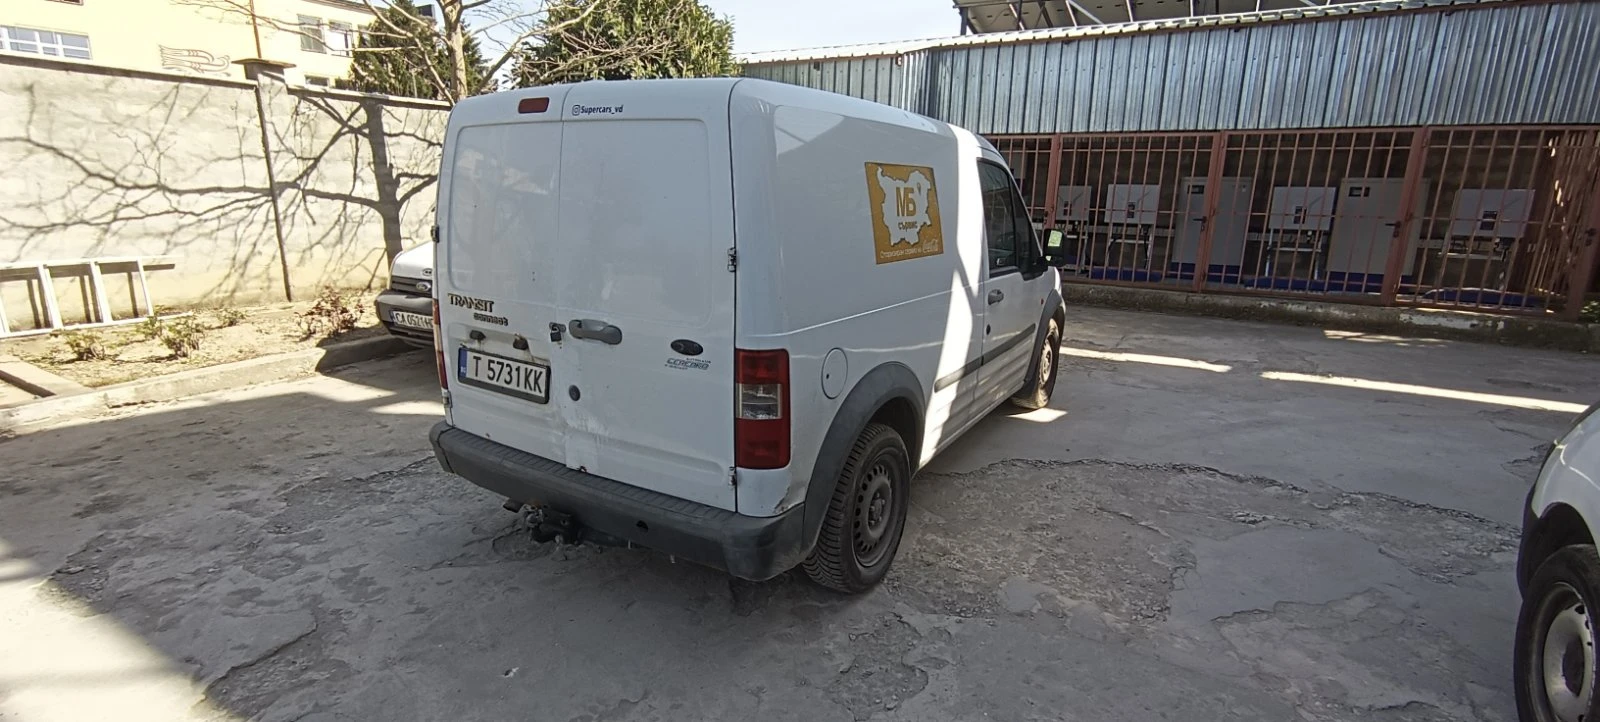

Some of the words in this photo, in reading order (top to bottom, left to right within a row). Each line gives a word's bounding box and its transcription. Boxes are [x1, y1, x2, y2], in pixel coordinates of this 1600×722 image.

[580, 104, 624, 115] Supercars_vd
[895, 186, 917, 217] МБ
[447, 293, 495, 312] TRANSIT
